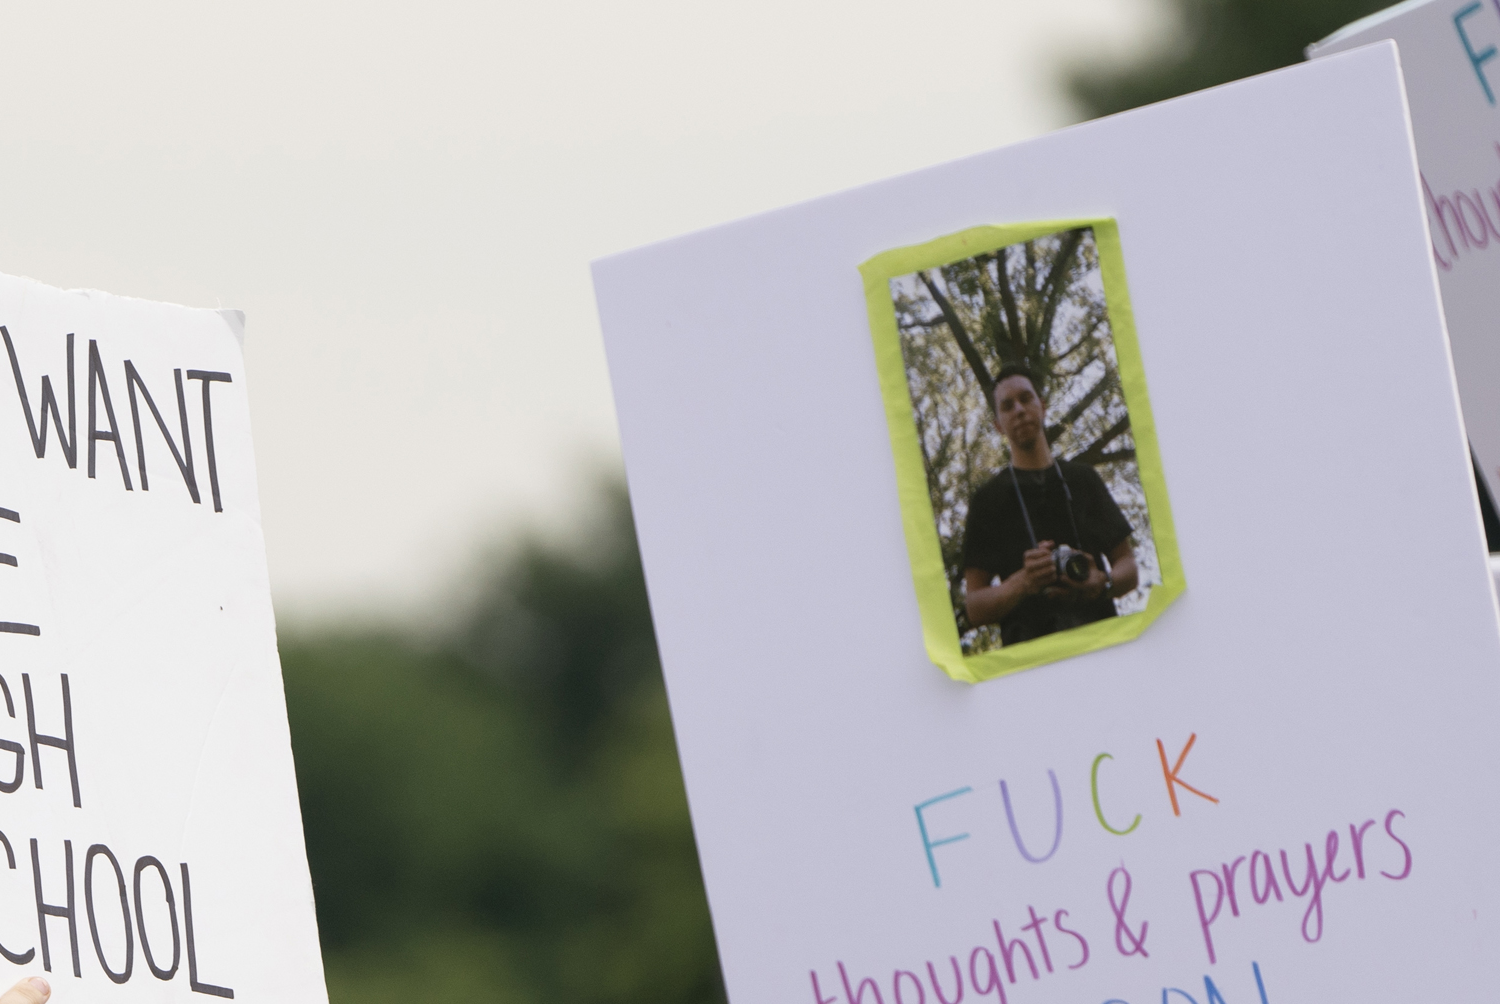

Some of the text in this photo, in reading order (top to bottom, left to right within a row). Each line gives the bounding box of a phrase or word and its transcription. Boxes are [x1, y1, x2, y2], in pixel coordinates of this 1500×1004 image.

[0, 325, 234, 515] WANT
[913, 733, 1219, 888] FUCK
[1107, 863, 1149, 958] &
[1189, 809, 1412, 965] prayers
